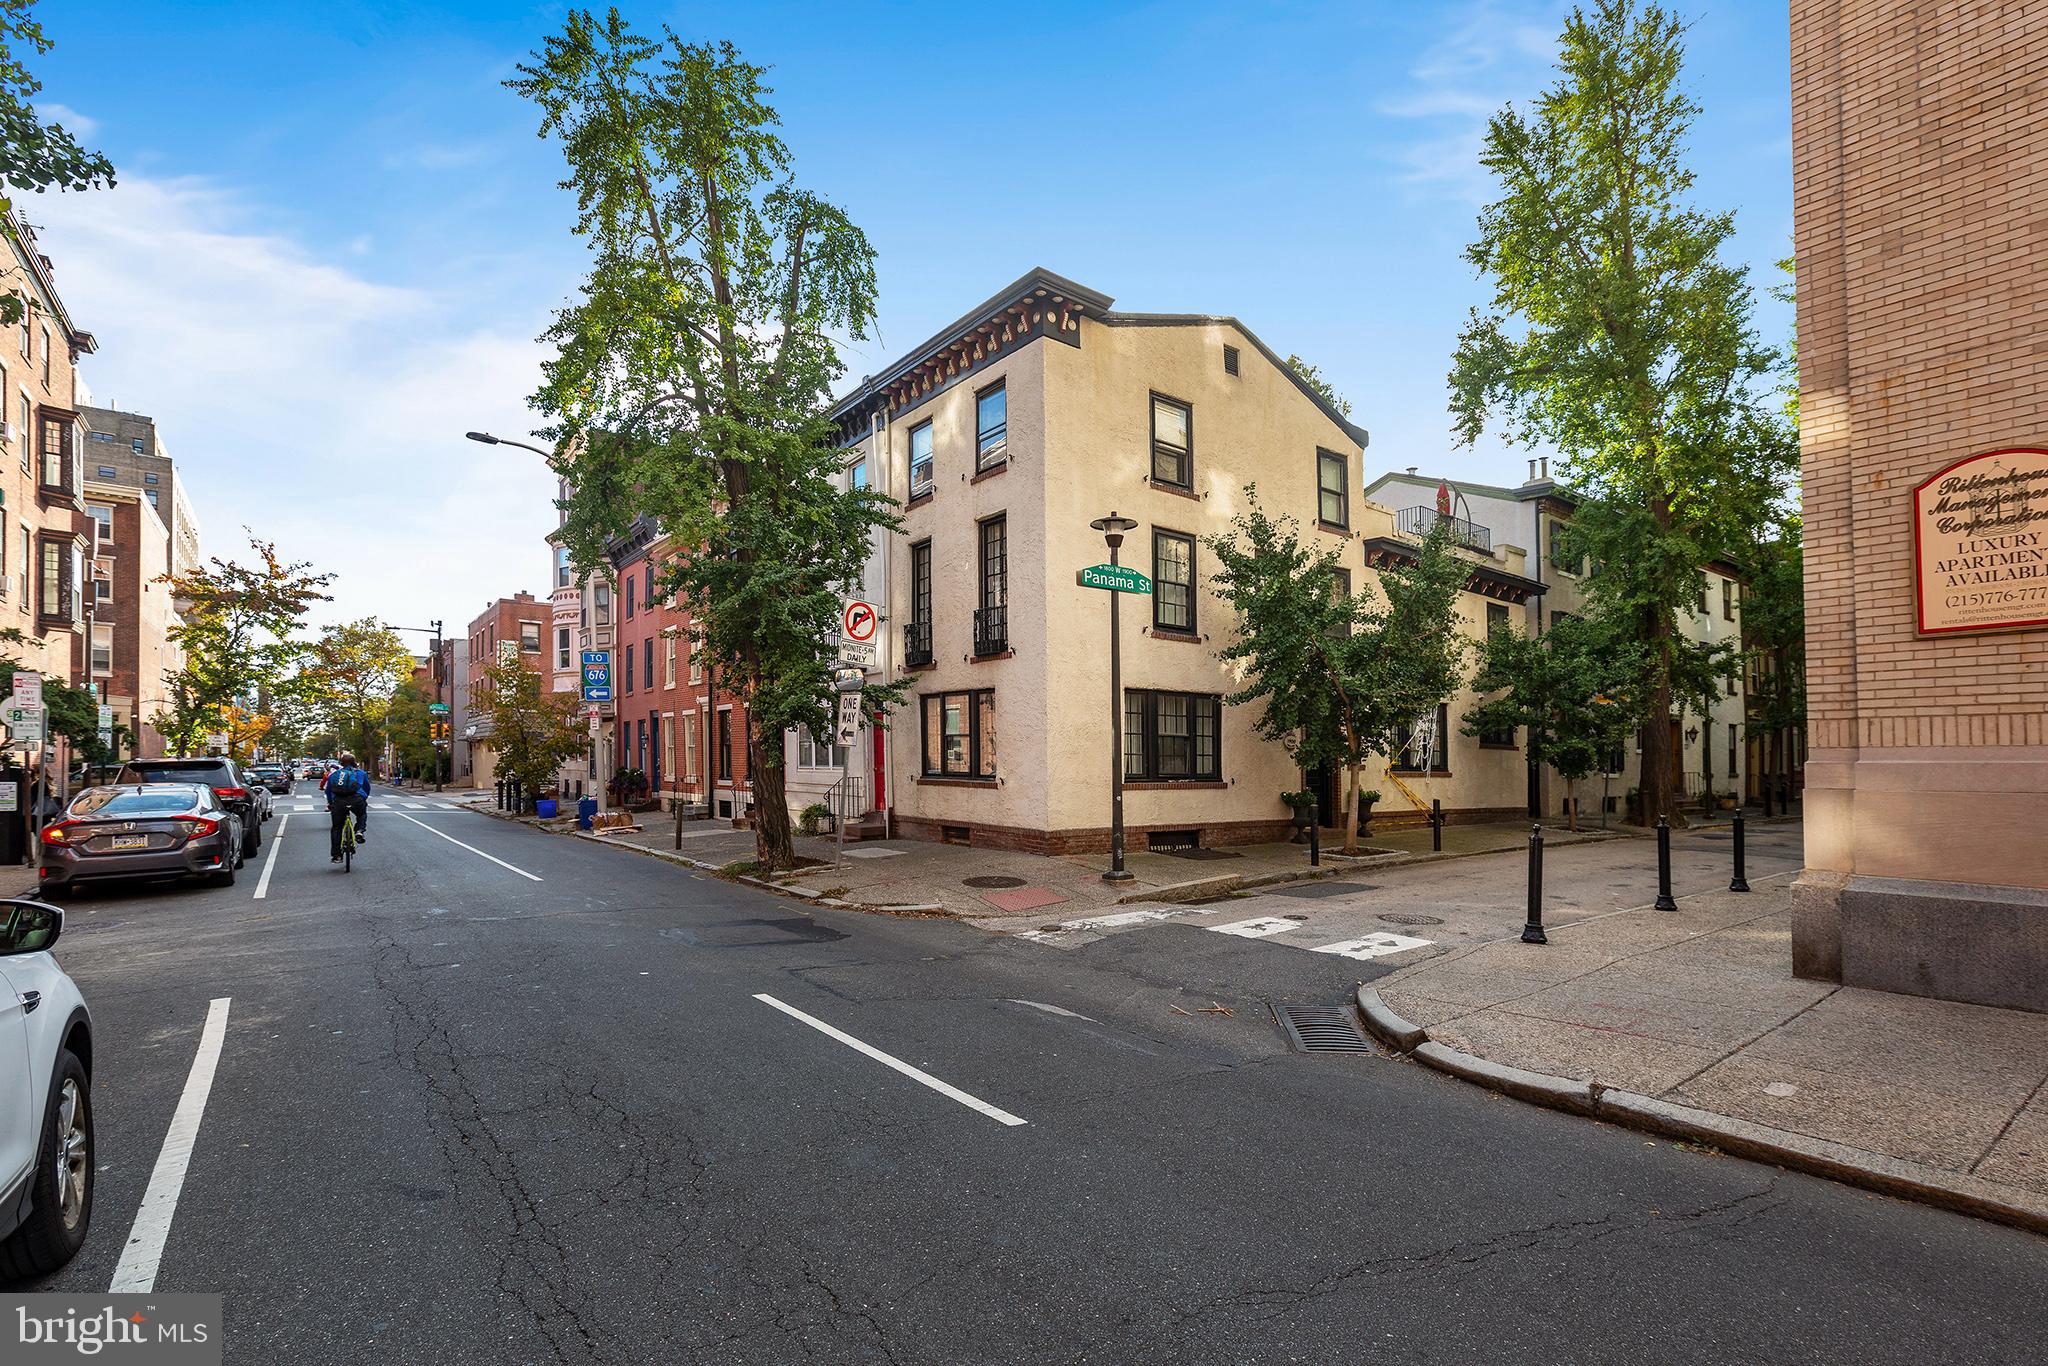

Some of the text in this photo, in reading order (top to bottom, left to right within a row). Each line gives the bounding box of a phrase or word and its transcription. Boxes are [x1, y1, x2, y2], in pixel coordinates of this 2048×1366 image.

[1958, 532, 2042, 554] LUXURY
[1084, 570, 1150, 592] Panama St
[1958, 602, 2046, 615] rittenhousemgt.com
[590, 654, 603, 662] TO
[847, 652, 867, 663] DAILY
[588, 670, 605, 680] 676
[843, 697, 857, 709] ONE
[842, 711, 856, 723] WAY
